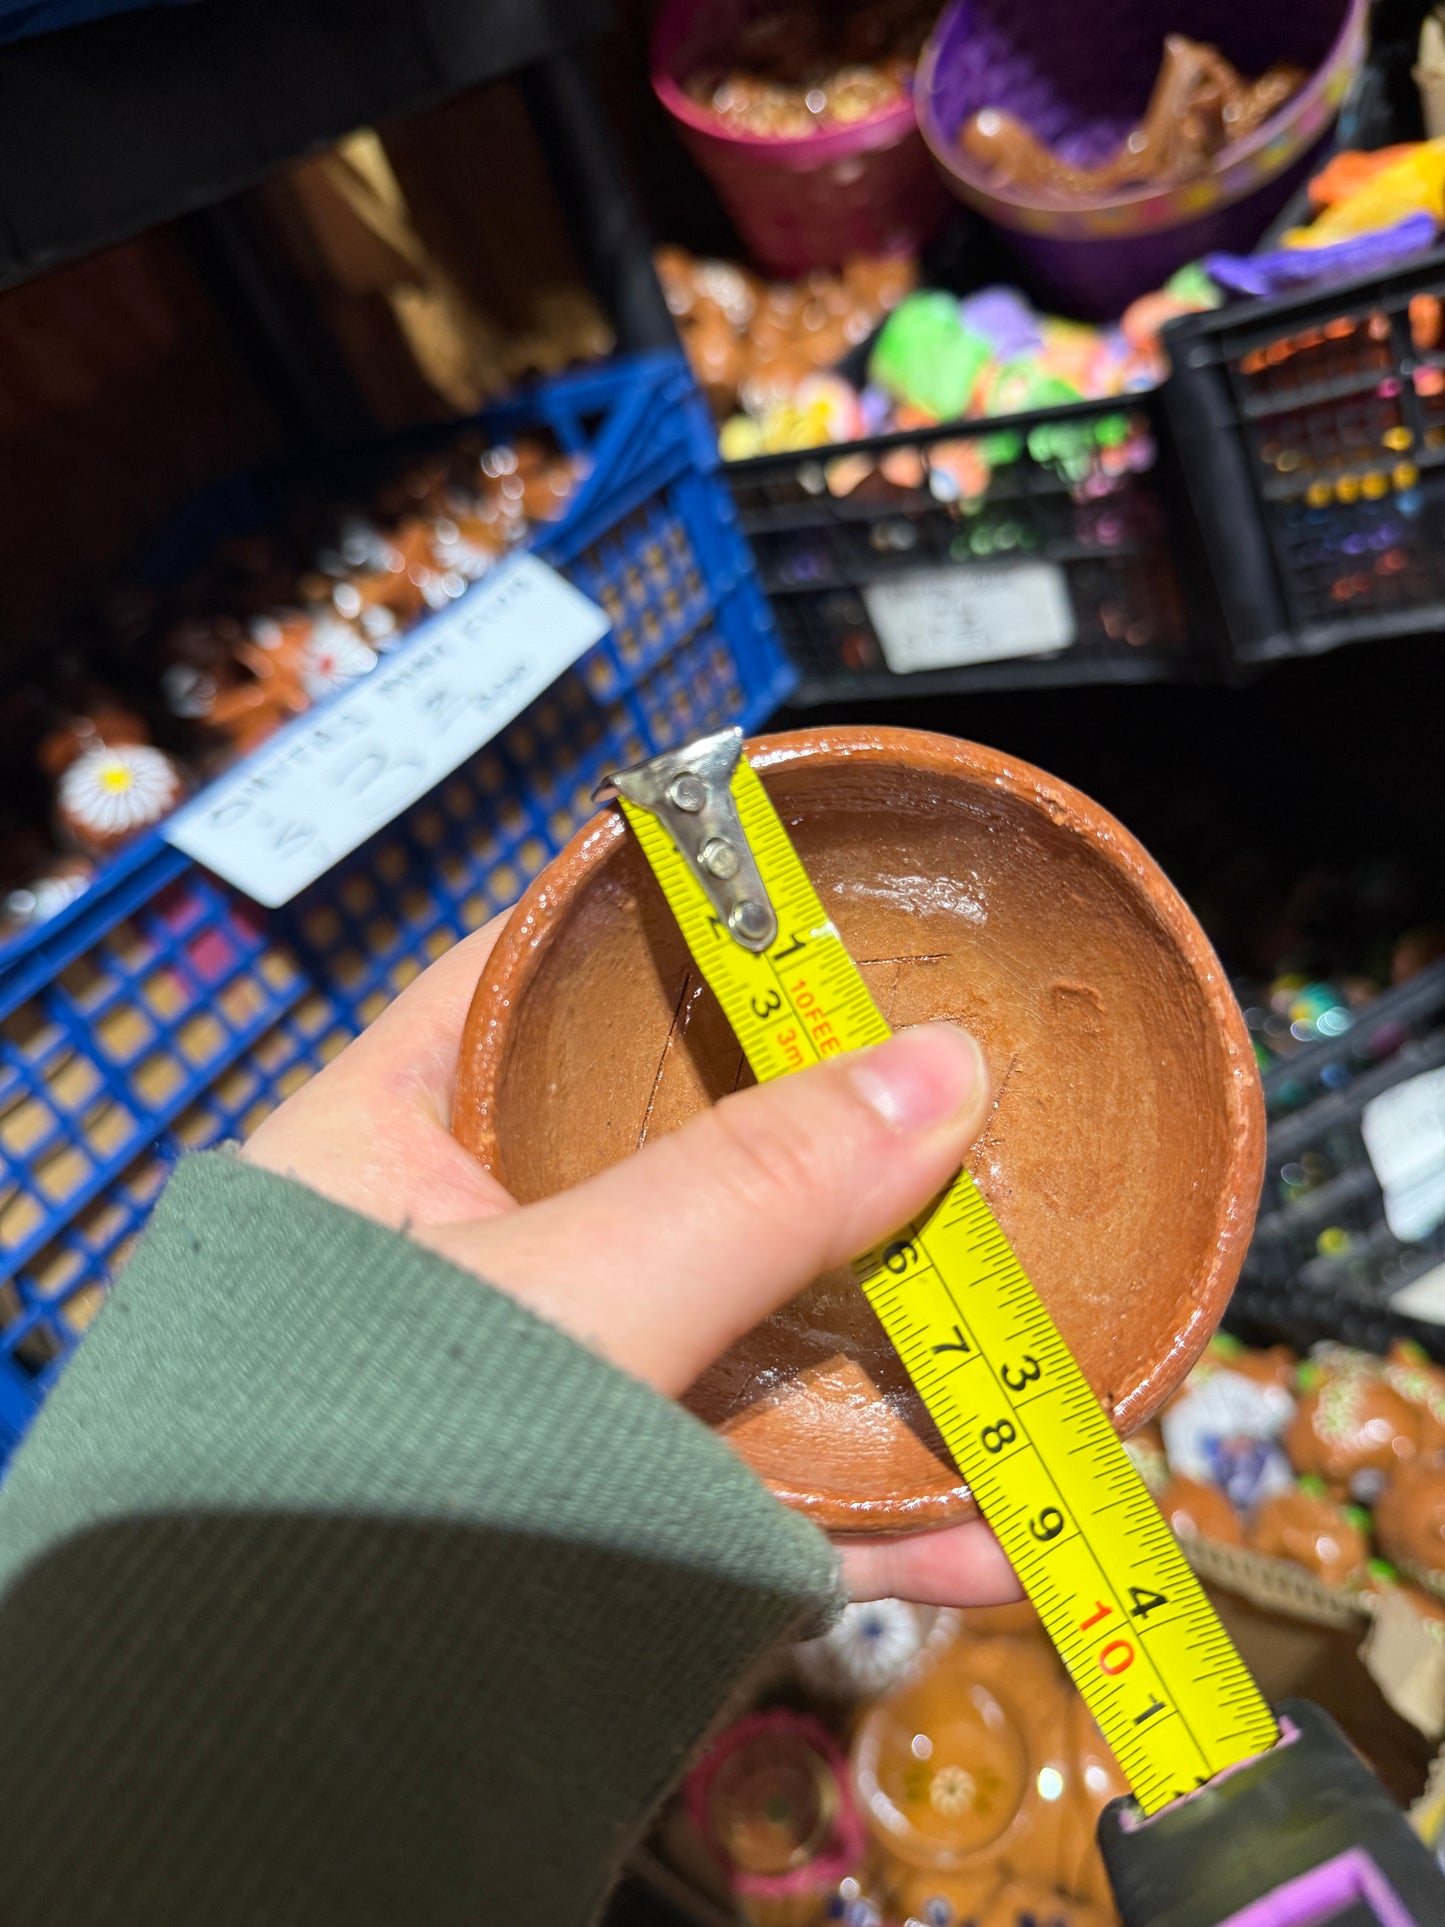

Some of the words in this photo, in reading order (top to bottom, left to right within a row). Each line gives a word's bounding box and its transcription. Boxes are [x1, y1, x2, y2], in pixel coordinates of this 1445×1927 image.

[774, 933, 807, 961] 1
[752, 989, 782, 1019] 3
[777, 1027, 803, 1068] 3m
[881, 1239, 919, 1275] 6
[930, 1325, 971, 1356] 7
[1000, 1354, 1042, 1392] 3
[980, 1418, 1017, 1454] 8
[1028, 1506, 1065, 1542] 9
[1128, 1586, 1169, 1620] 4
[1079, 1600, 1135, 1677] 10
[1133, 1692, 1168, 1726] 1
